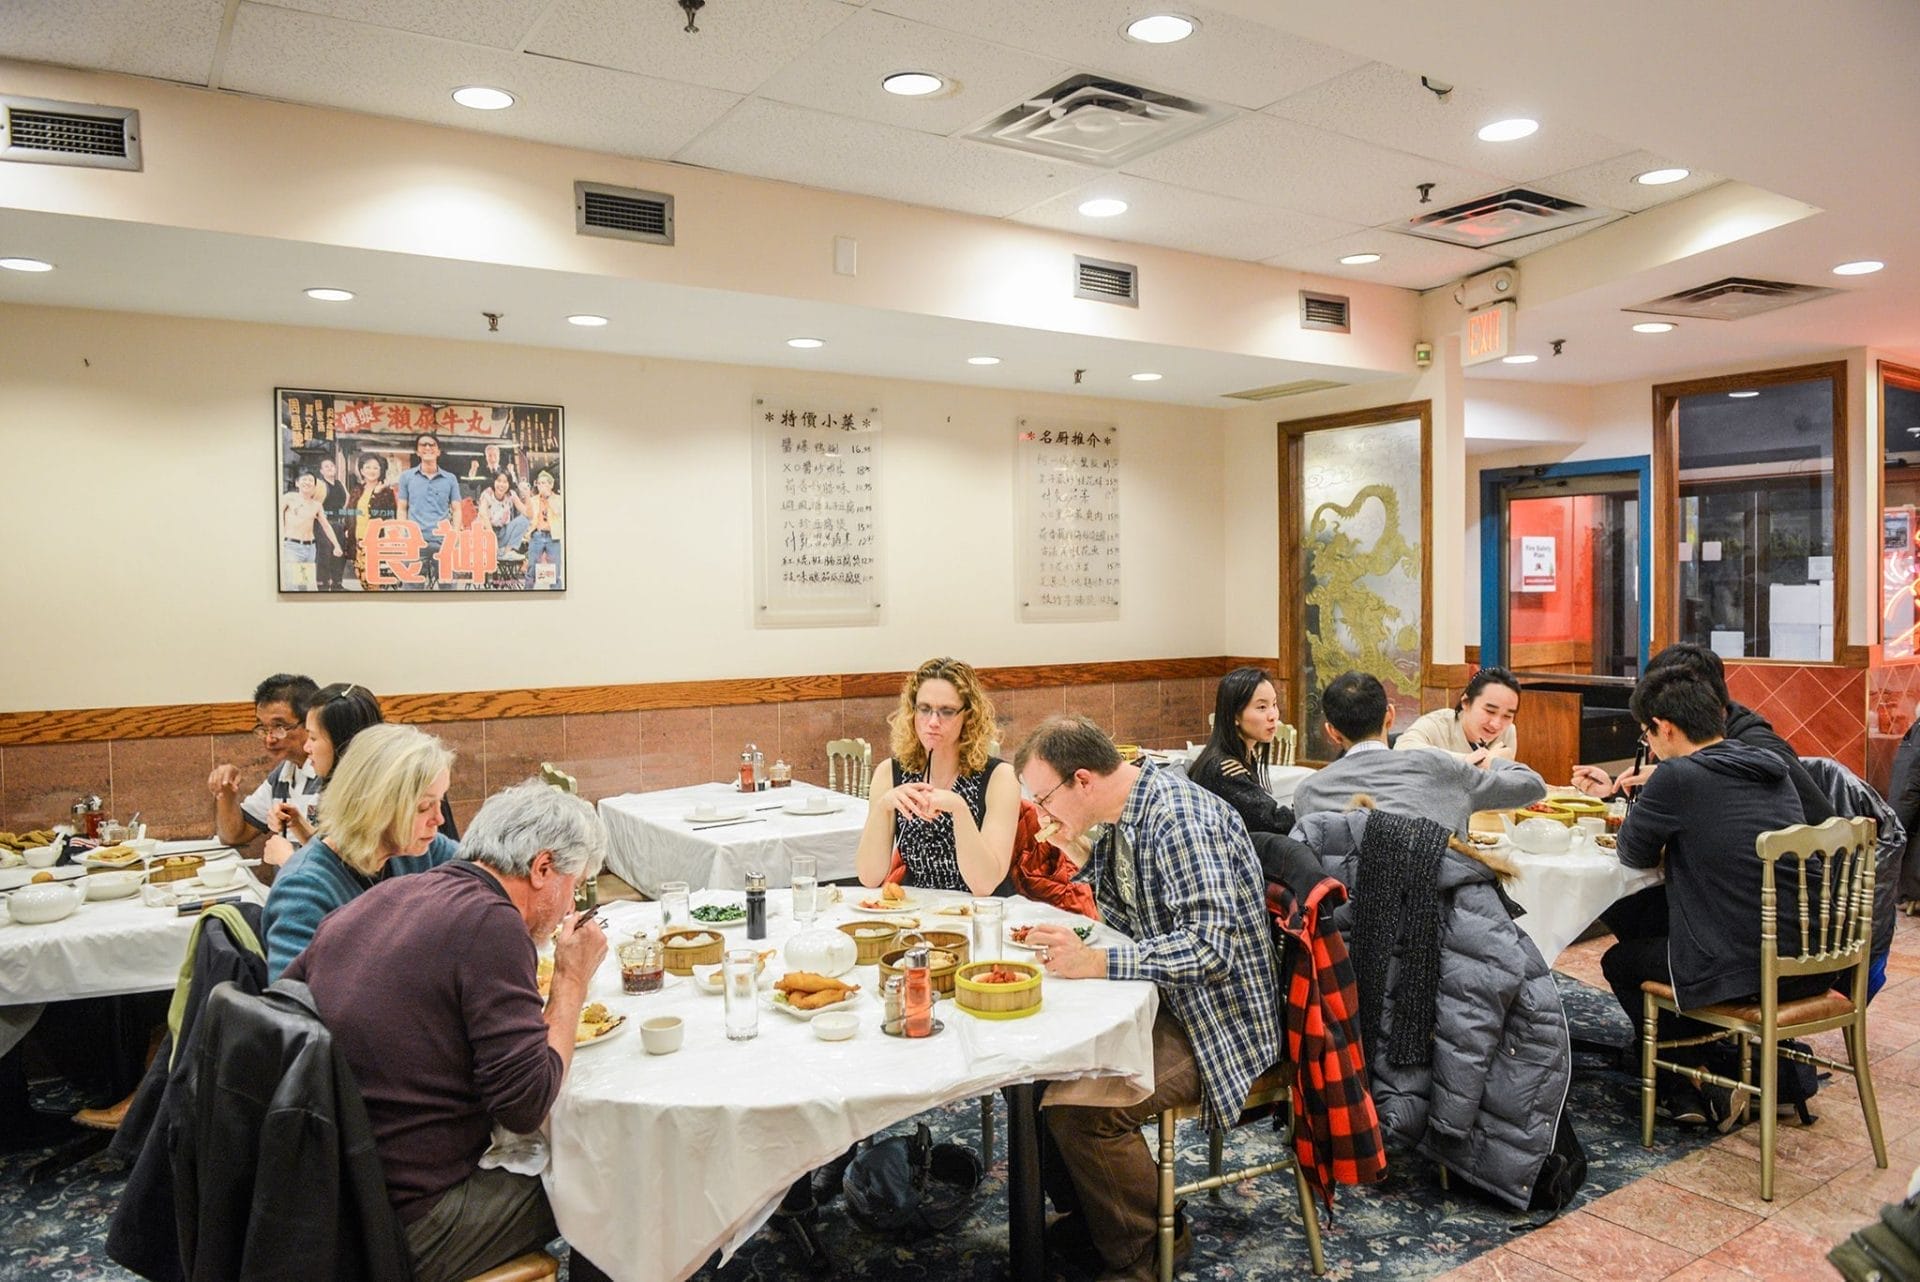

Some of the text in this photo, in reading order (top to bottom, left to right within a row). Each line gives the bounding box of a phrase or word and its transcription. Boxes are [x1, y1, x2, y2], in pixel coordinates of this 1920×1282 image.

[1469, 309, 1502, 358] EXIT
[780, 409, 857, 431] 特價小菜
[359, 518, 498, 585] 食神
